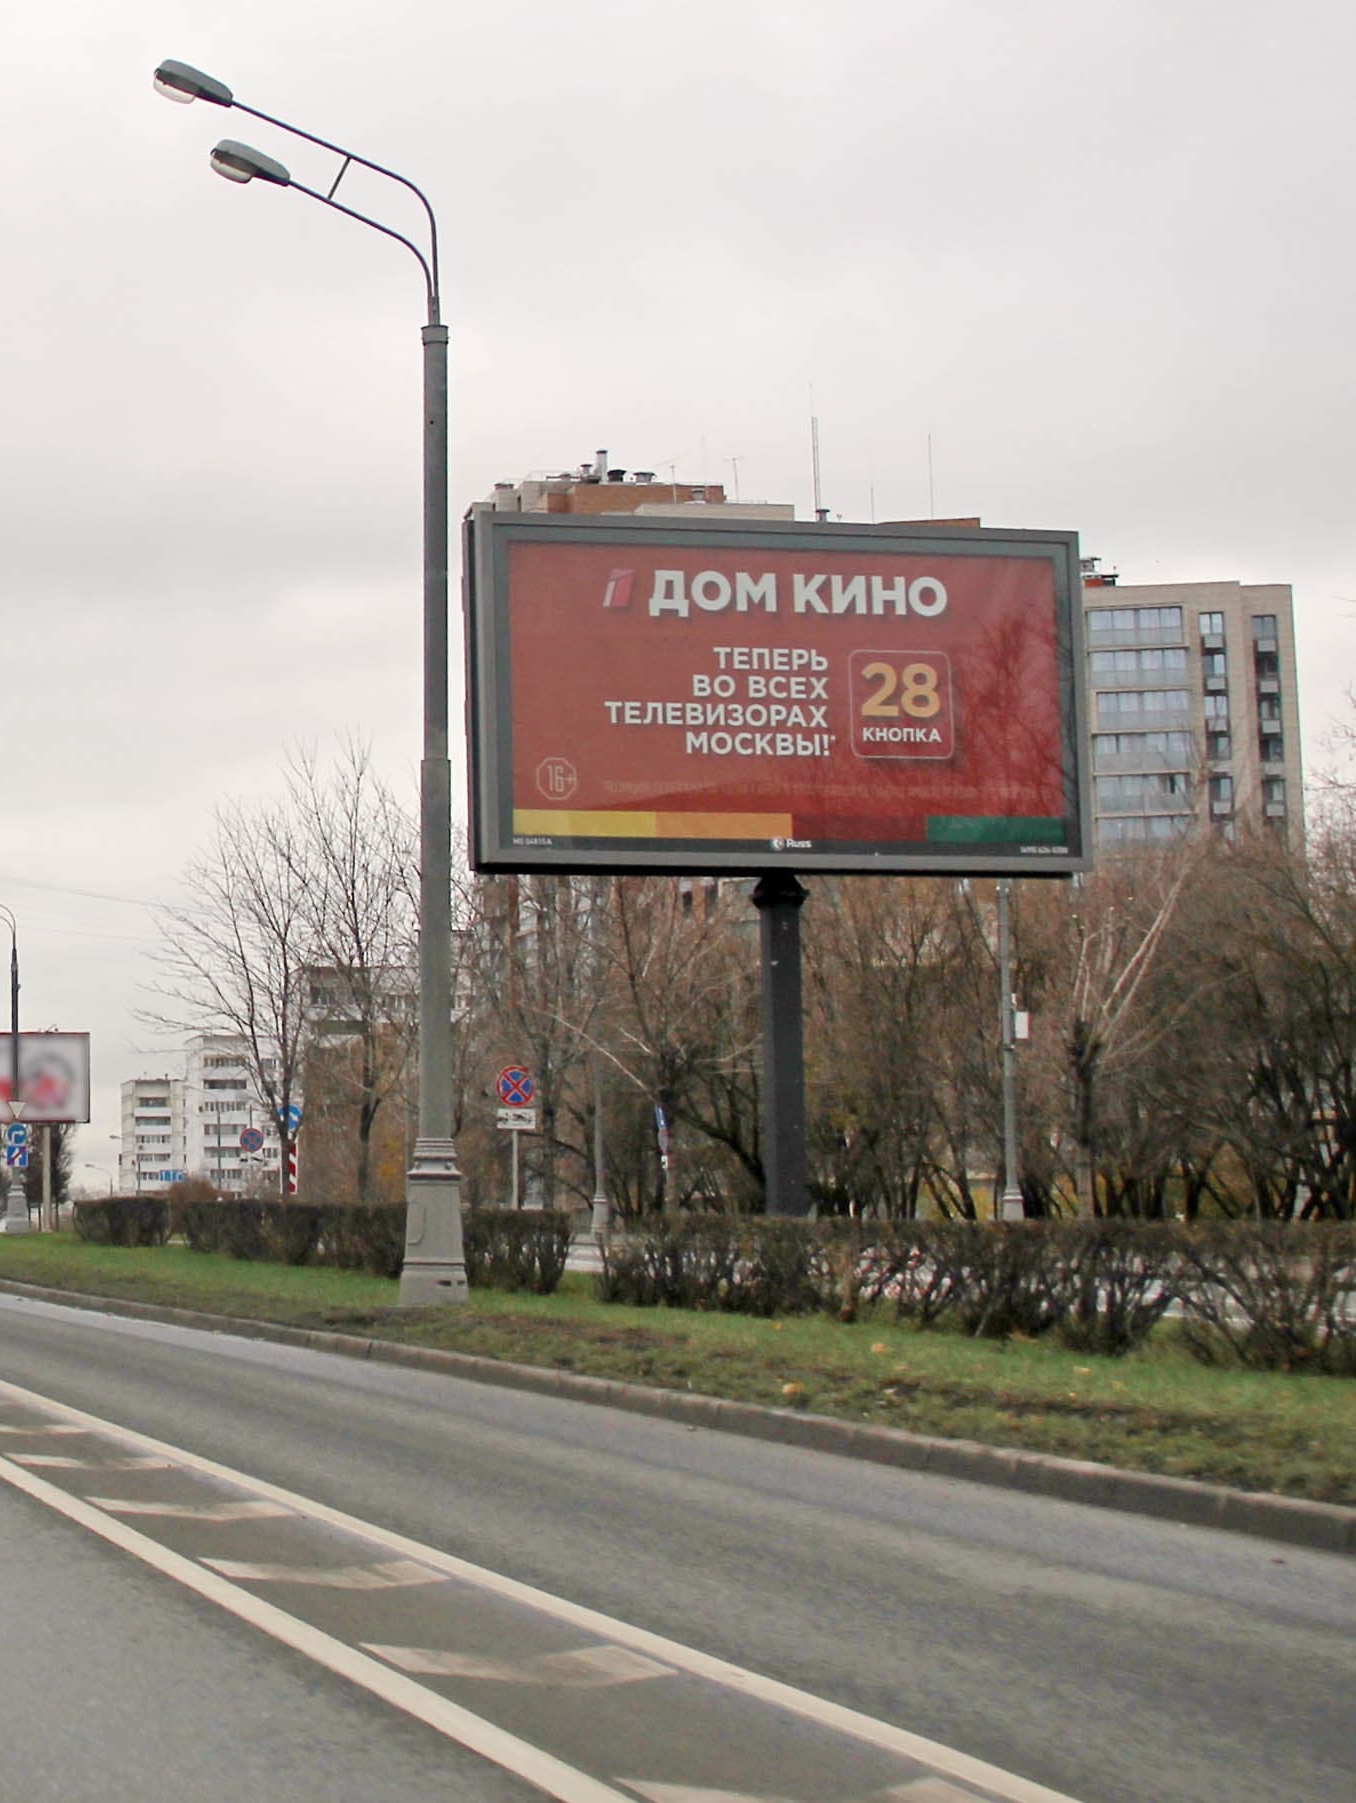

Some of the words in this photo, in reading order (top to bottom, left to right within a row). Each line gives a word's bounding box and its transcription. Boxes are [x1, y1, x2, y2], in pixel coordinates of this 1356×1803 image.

[648, 569, 778, 618] ДОМ
[792, 573, 949, 617] КИНО
[713, 646, 829, 671] ТЕПЕРЬ
[692, 674, 736, 698] ВО
[748, 675, 829, 699] ВСЕХ
[860, 662, 941, 718] 28
[604, 701, 829, 728] ТЕЛЕВИЗОРАХ
[862, 727, 942, 743] КНОПКА
[547, 765, 576, 793] 16+
[786, 839, 812, 849] Russ
